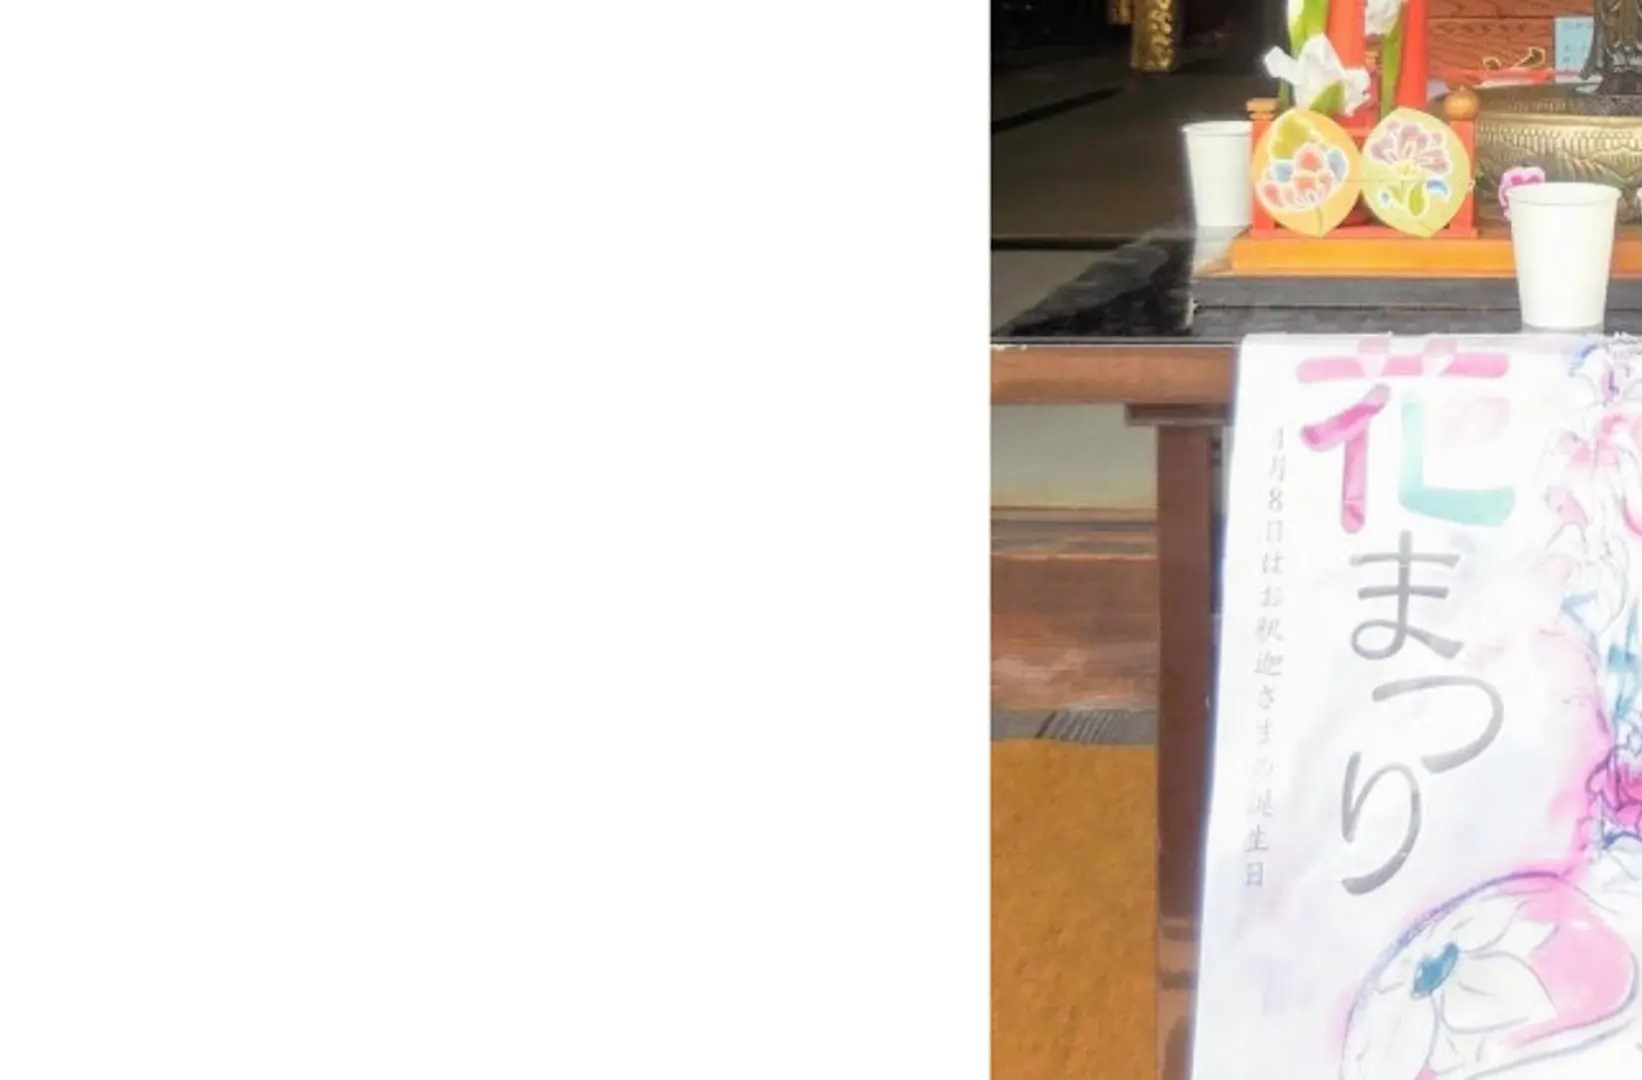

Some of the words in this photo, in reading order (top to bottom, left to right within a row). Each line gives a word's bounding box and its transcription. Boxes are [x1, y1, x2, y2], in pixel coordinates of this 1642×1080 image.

[1243, 428, 1286, 889] 4月8日はお釈迦さまの誕生日
[1296, 338, 1517, 897] 花まつり
